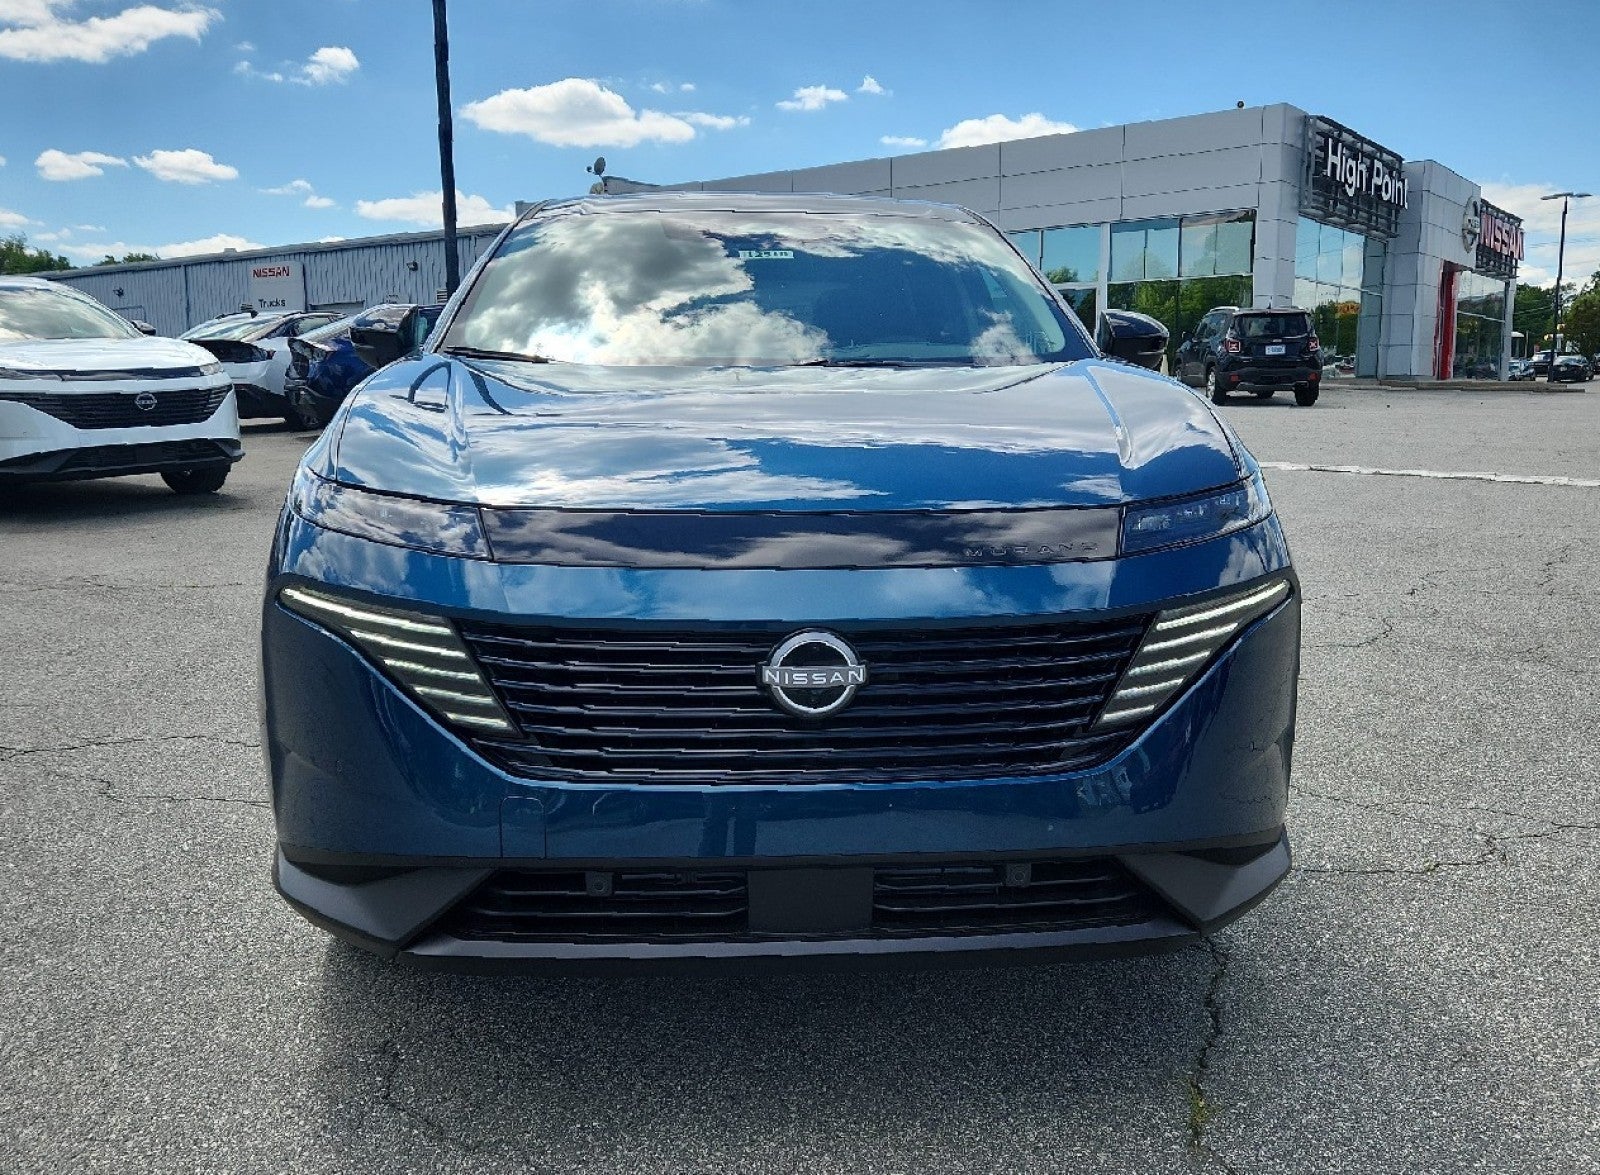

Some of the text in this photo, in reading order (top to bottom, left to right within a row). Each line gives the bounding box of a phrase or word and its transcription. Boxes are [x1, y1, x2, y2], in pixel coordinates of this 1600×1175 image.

[1327, 137, 1409, 210] High Point
[1480, 212, 1525, 261] NISSAN
[252, 265, 290, 278] NISSAN
[258, 298, 286, 308] Trucks
[764, 669, 864, 685] NISSAN
